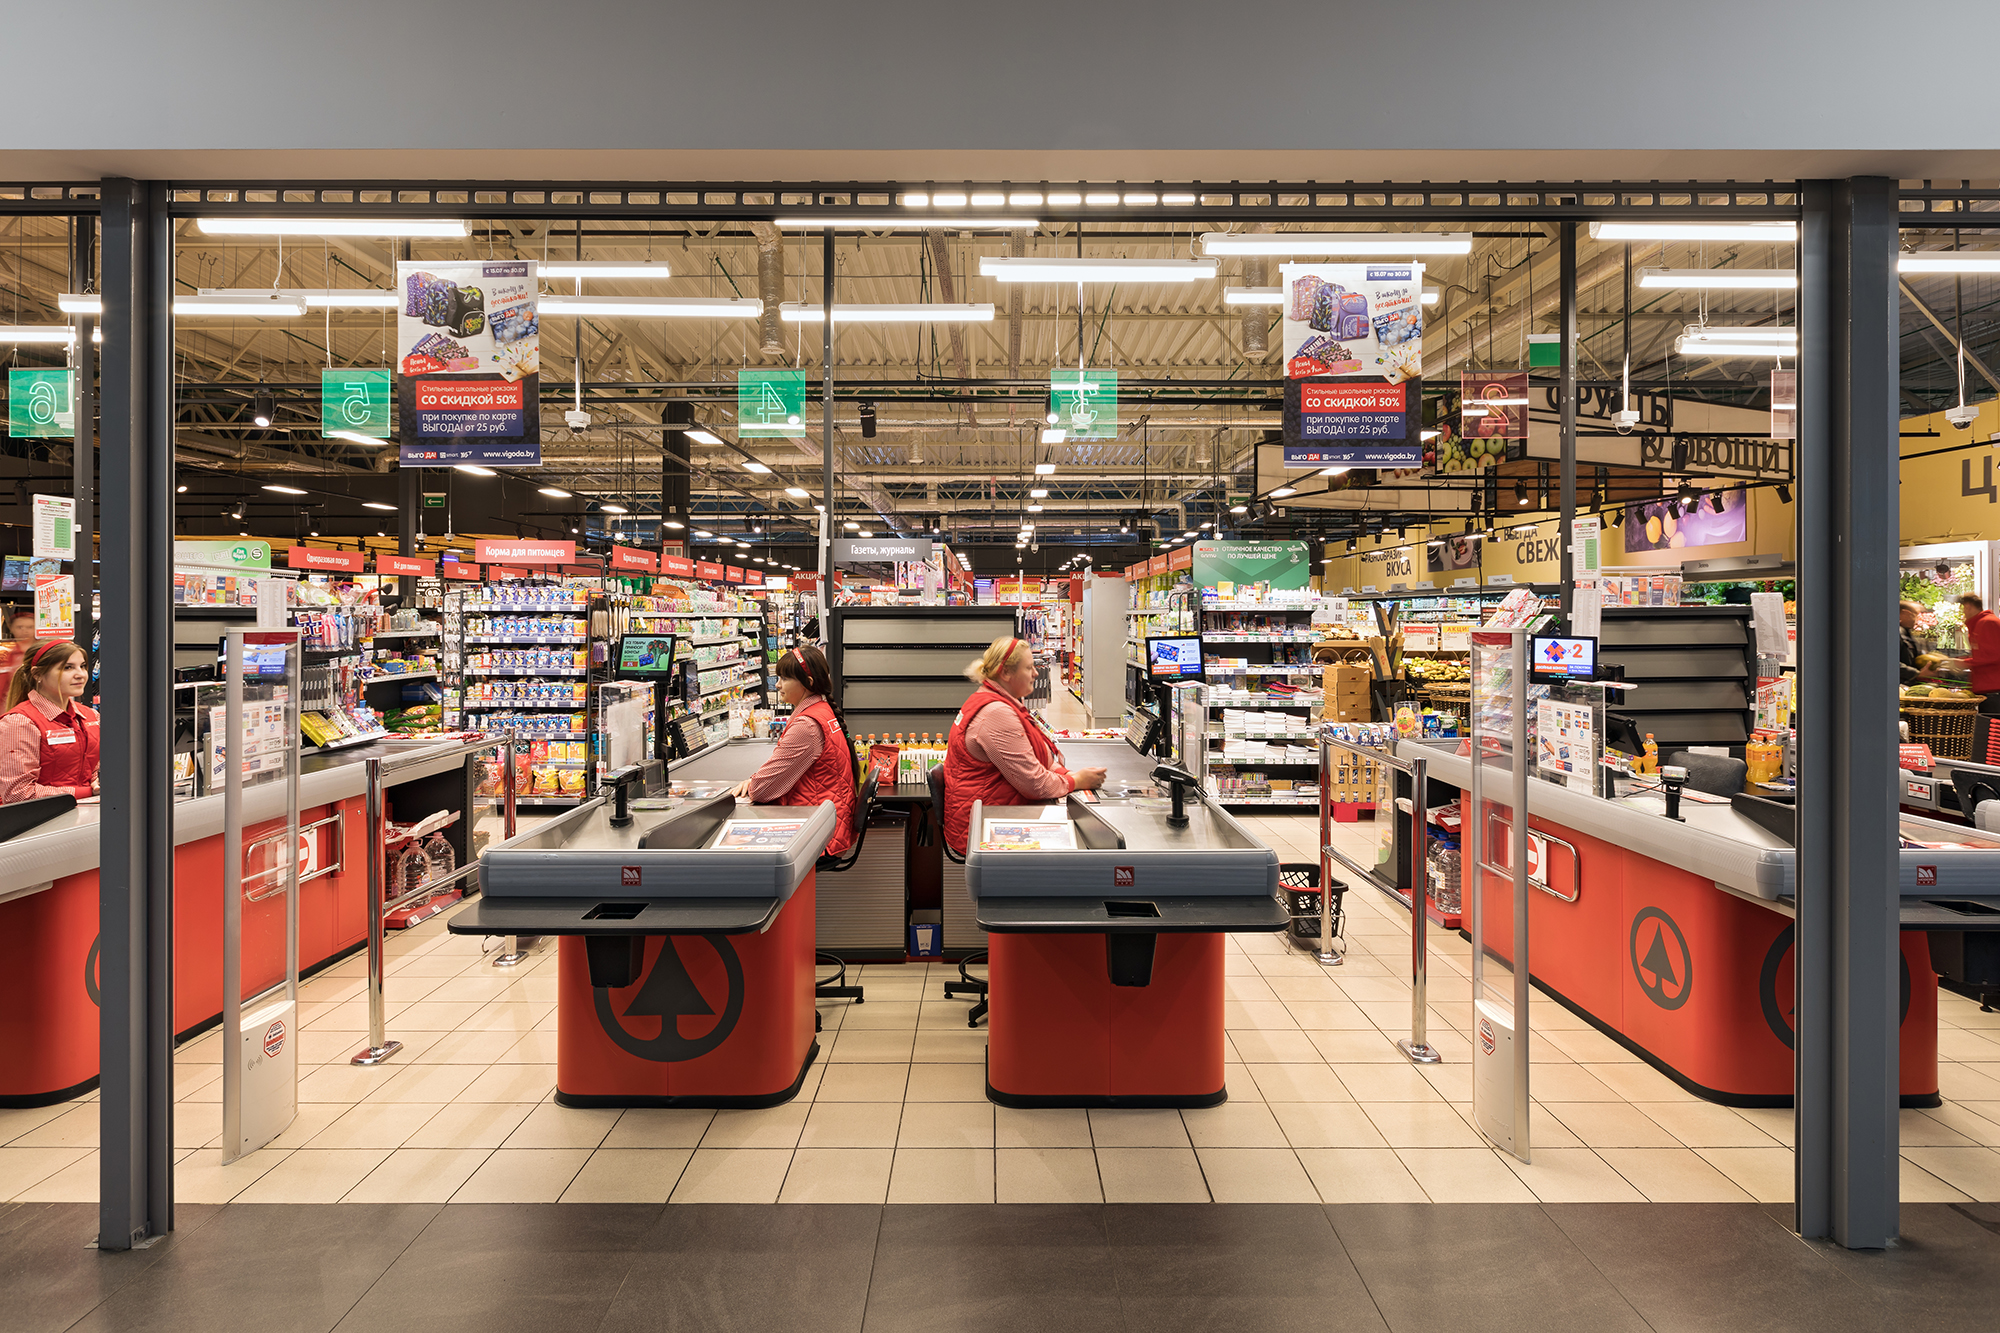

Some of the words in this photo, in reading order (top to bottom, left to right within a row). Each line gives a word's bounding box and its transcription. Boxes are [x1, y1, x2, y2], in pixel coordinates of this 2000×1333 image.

[421, 395, 437, 405] СО
[440, 394, 494, 406] СКИДКОЙ
[496, 395, 518, 405] 50%
[1306, 397, 1321, 407] СО
[1324, 396, 1376, 409] СКИДКОЙ
[1379, 397, 1400, 407] 50%
[1546, 386, 1674, 427] ФРУТЫ
[422, 413, 440, 421] при
[442, 413, 477, 422] покупке
[492, 413, 517, 421] карте
[1306, 416, 1323, 424] при
[1324, 416, 1360, 424] покупке
[1375, 416, 1399, 424] карте
[422, 423, 463, 433] ВЫГОДА!
[477, 423, 488, 432] 25
[489, 423, 508, 433] руб.
[1306, 426, 1346, 435] ВЫГОДА!
[1359, 425, 1370, 434] 25
[1372, 426, 1390, 436] руб.
[483, 451, 535, 459] www.vigoda.by
[1365, 453, 1416, 461] www.vigoda.by
[485, 546, 510, 558] Корма
[511, 548, 526, 557] для
[527, 549, 566, 558] питомцев
[850, 544, 879, 556] Газеты,
[879, 546, 916, 557] журналы
[1516, 538, 1560, 564] СВЕЖ
[307, 553, 335, 564] Одноразовая
[335, 558, 350, 566] посуда
[1386, 559, 1412, 577] ВКУСА
[794, 573, 822, 581] АКЦИЯ
[1572, 643, 1583, 658] 2
